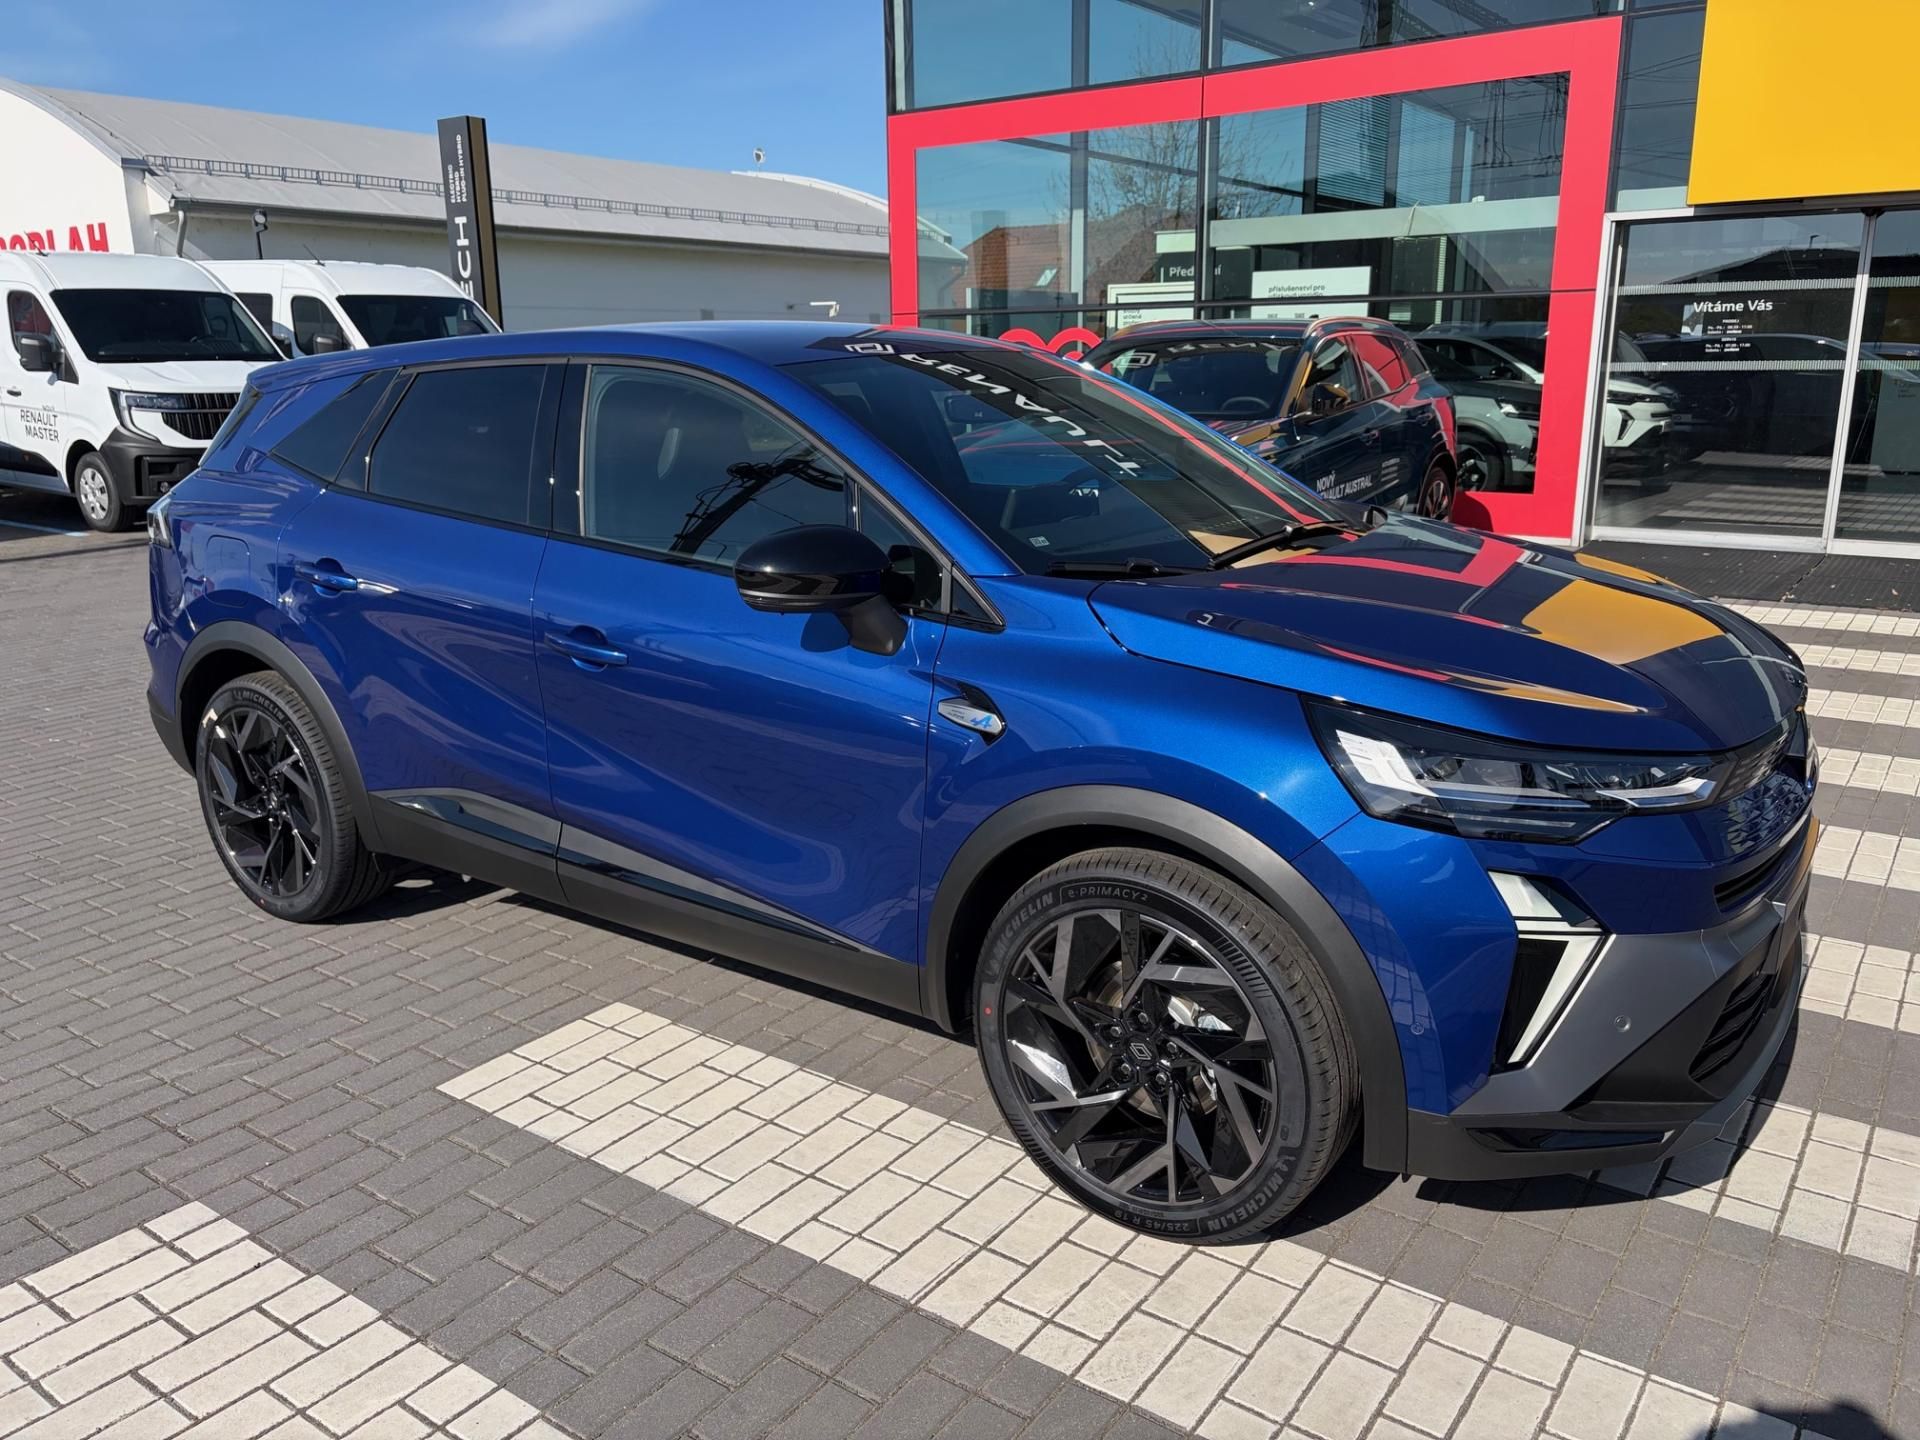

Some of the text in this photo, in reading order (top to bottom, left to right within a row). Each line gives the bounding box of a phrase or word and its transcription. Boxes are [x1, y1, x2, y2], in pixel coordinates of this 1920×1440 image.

[455, 134, 464, 167] HYBRID
[1693, 299, 1773, 313] Vítáme Vás
[20, 409, 58, 427] RENAULT
[25, 424, 60, 443] MASTER
[1316, 470, 1336, 492] NOVÝ
[1344, 474, 1373, 496] AUSTRAL
[242, 691, 285, 720] MICHELIN
[992, 891, 1054, 958] MICHELIN
[1207, 1174, 1285, 1232] MICHELIN
[1132, 1216, 1141, 1225] R
[1145, 1219, 1190, 1232] 225/45
